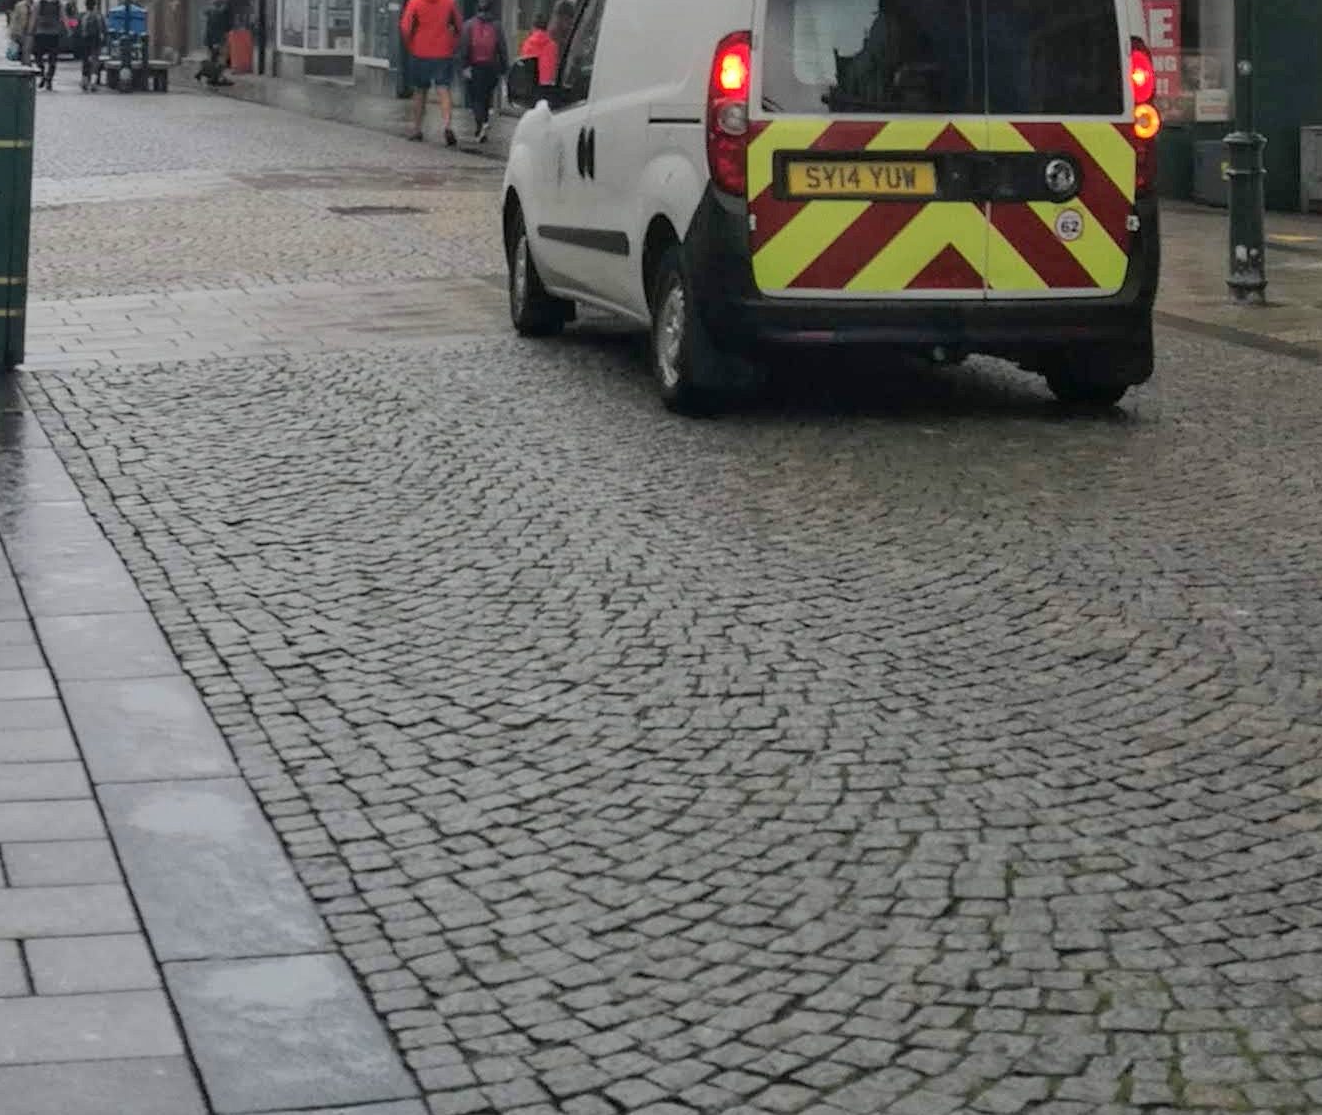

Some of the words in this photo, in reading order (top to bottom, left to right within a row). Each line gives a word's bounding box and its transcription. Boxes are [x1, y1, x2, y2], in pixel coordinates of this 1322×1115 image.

[804, 166, 862, 190] SY14
[869, 166, 917, 190] YUW
[1060, 219, 1079, 234] 62
